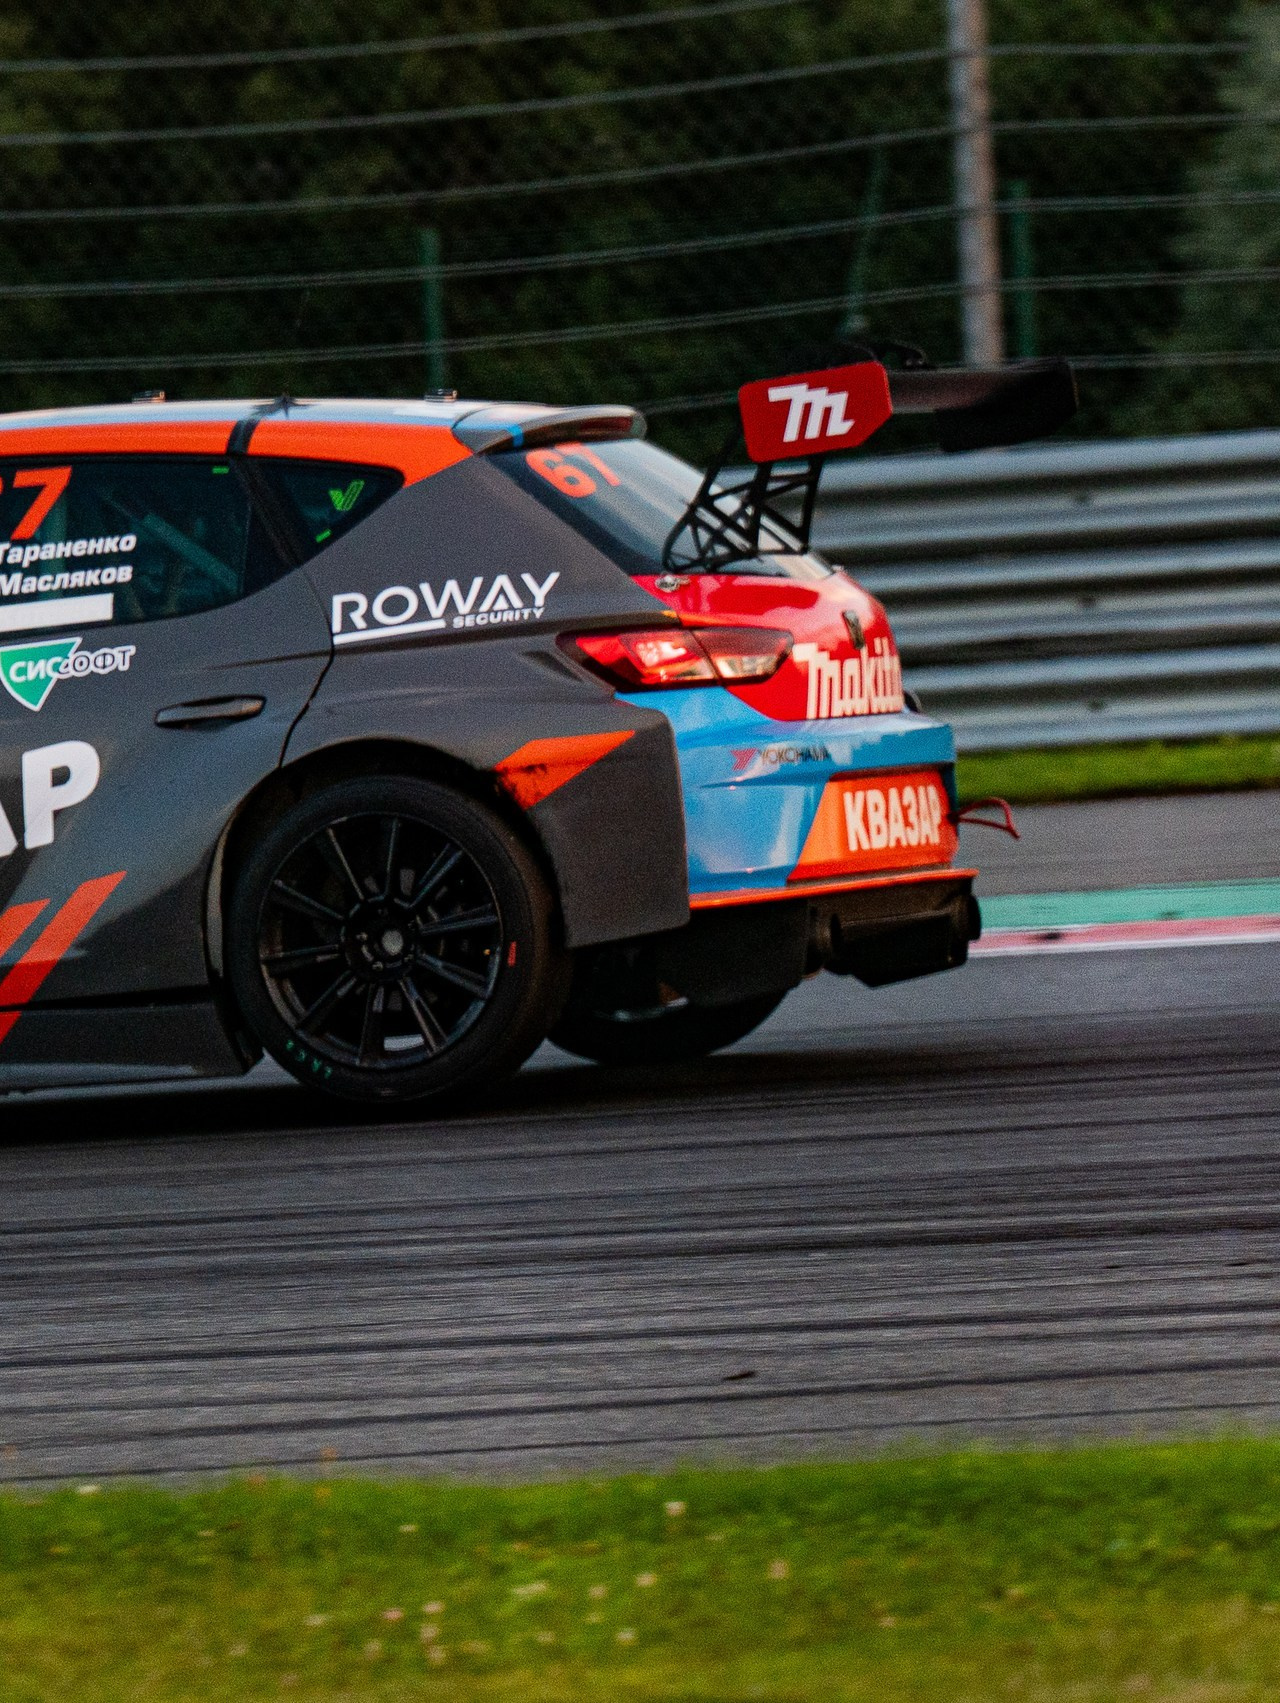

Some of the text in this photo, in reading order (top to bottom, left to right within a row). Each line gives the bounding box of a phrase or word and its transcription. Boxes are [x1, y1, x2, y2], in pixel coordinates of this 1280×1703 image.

[525, 441, 621, 498] 67
[331, 571, 561, 634] ROWAY
[452, 607, 545, 629] SECURITY
[843, 784, 942, 852] КВАЗАР
